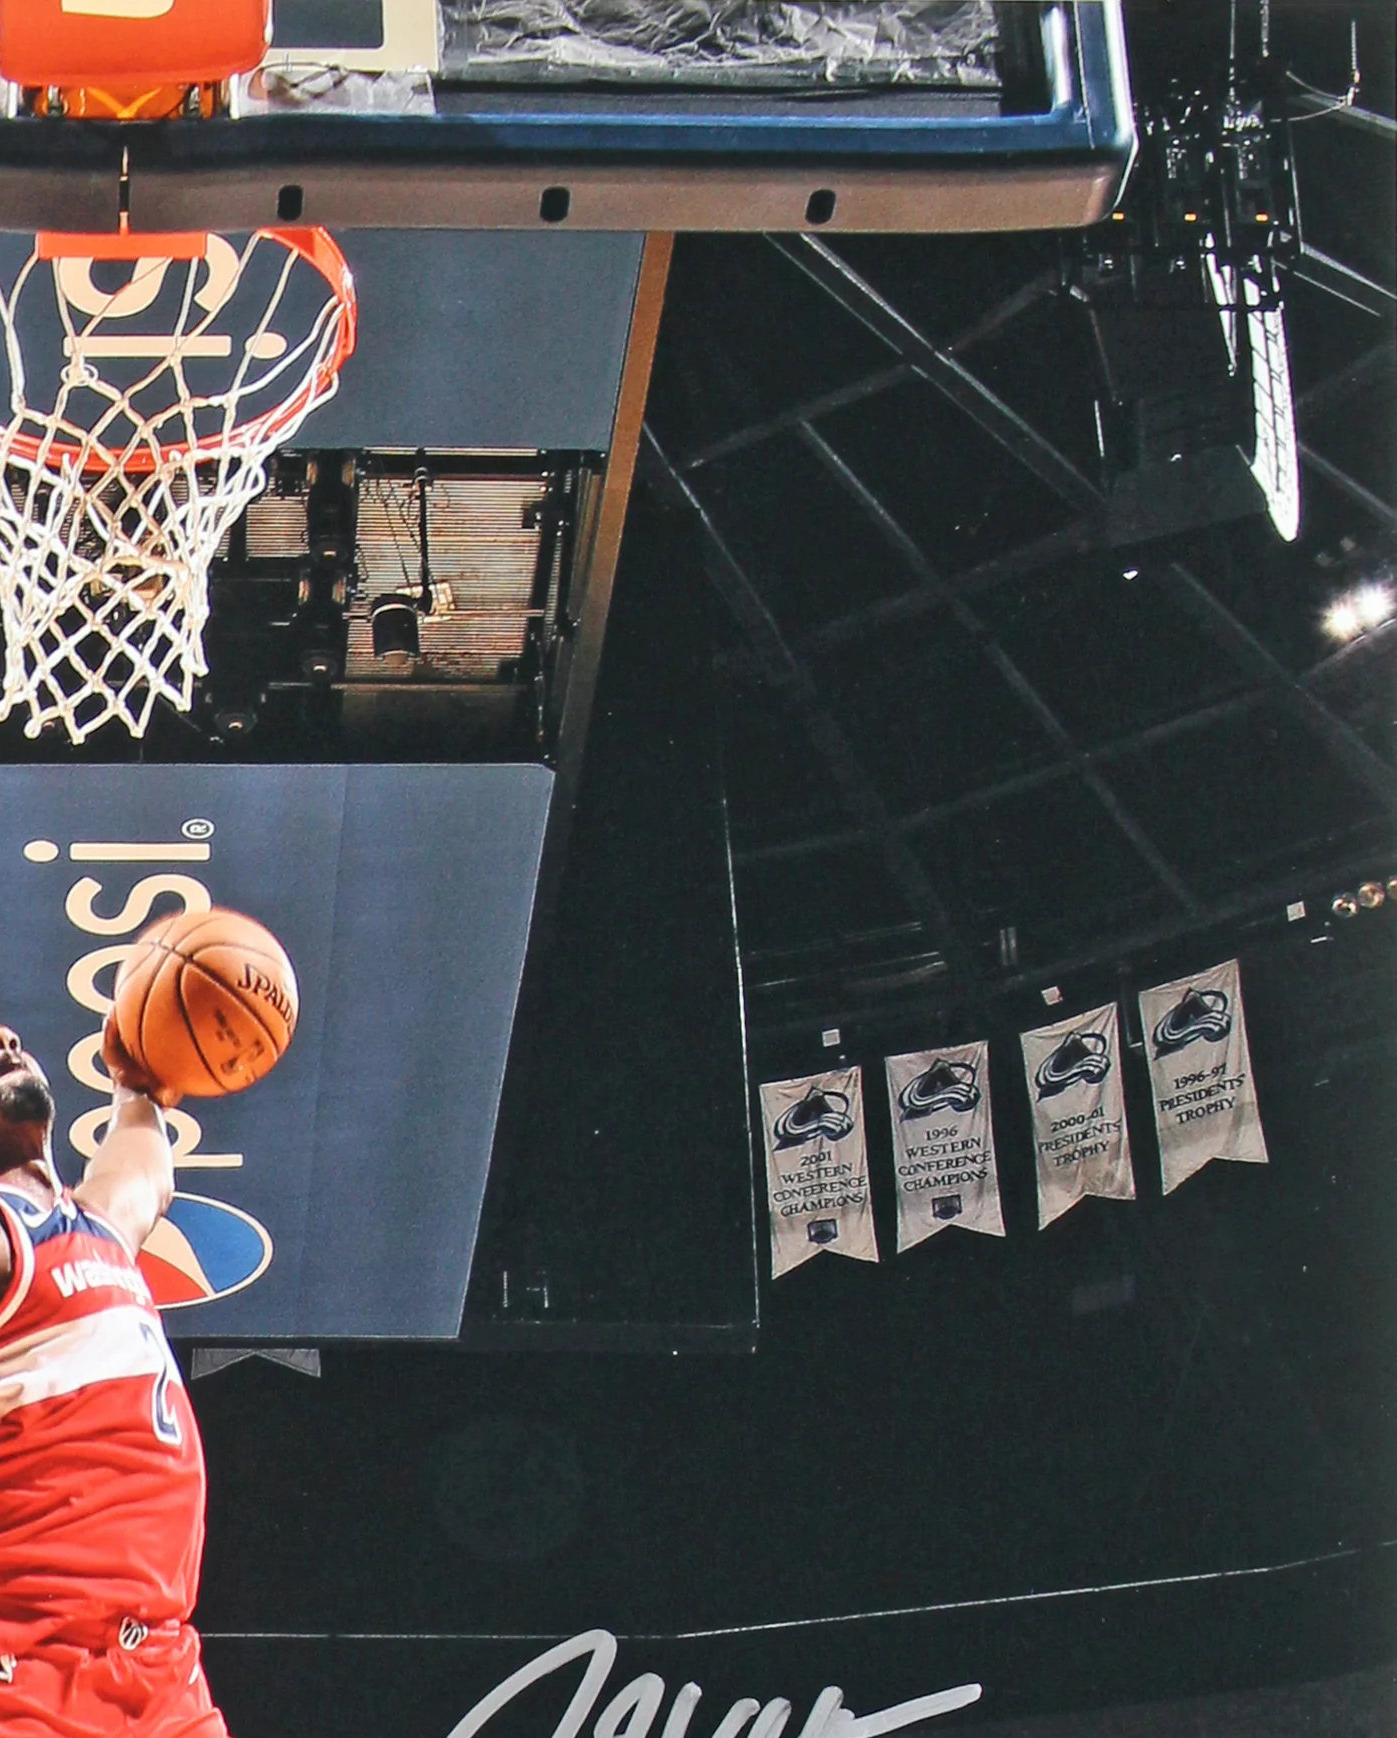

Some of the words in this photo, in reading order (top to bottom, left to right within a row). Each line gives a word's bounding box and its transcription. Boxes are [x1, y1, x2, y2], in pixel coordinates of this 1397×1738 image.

[1174, 1062, 1226, 1090] 1996-97
[1051, 1107, 1105, 1132] 2000-01
[1175, 1096, 1237, 1125] TROPHY
[926, 1125, 958, 1141] 1996
[801, 1151, 832, 1166] 2001
[905, 1137, 981, 1159] WESTERN
[1054, 1141, 1109, 1167] TROPHY
[781, 1163, 852, 1185] WESTERN
[898, 1151, 991, 1177] CONFERENCE
[773, 1175, 867, 1203] CONFERENCE
[903, 1167, 988, 1192] CHAMPIONS
[781, 1192, 864, 1217] CHAMPIONS
